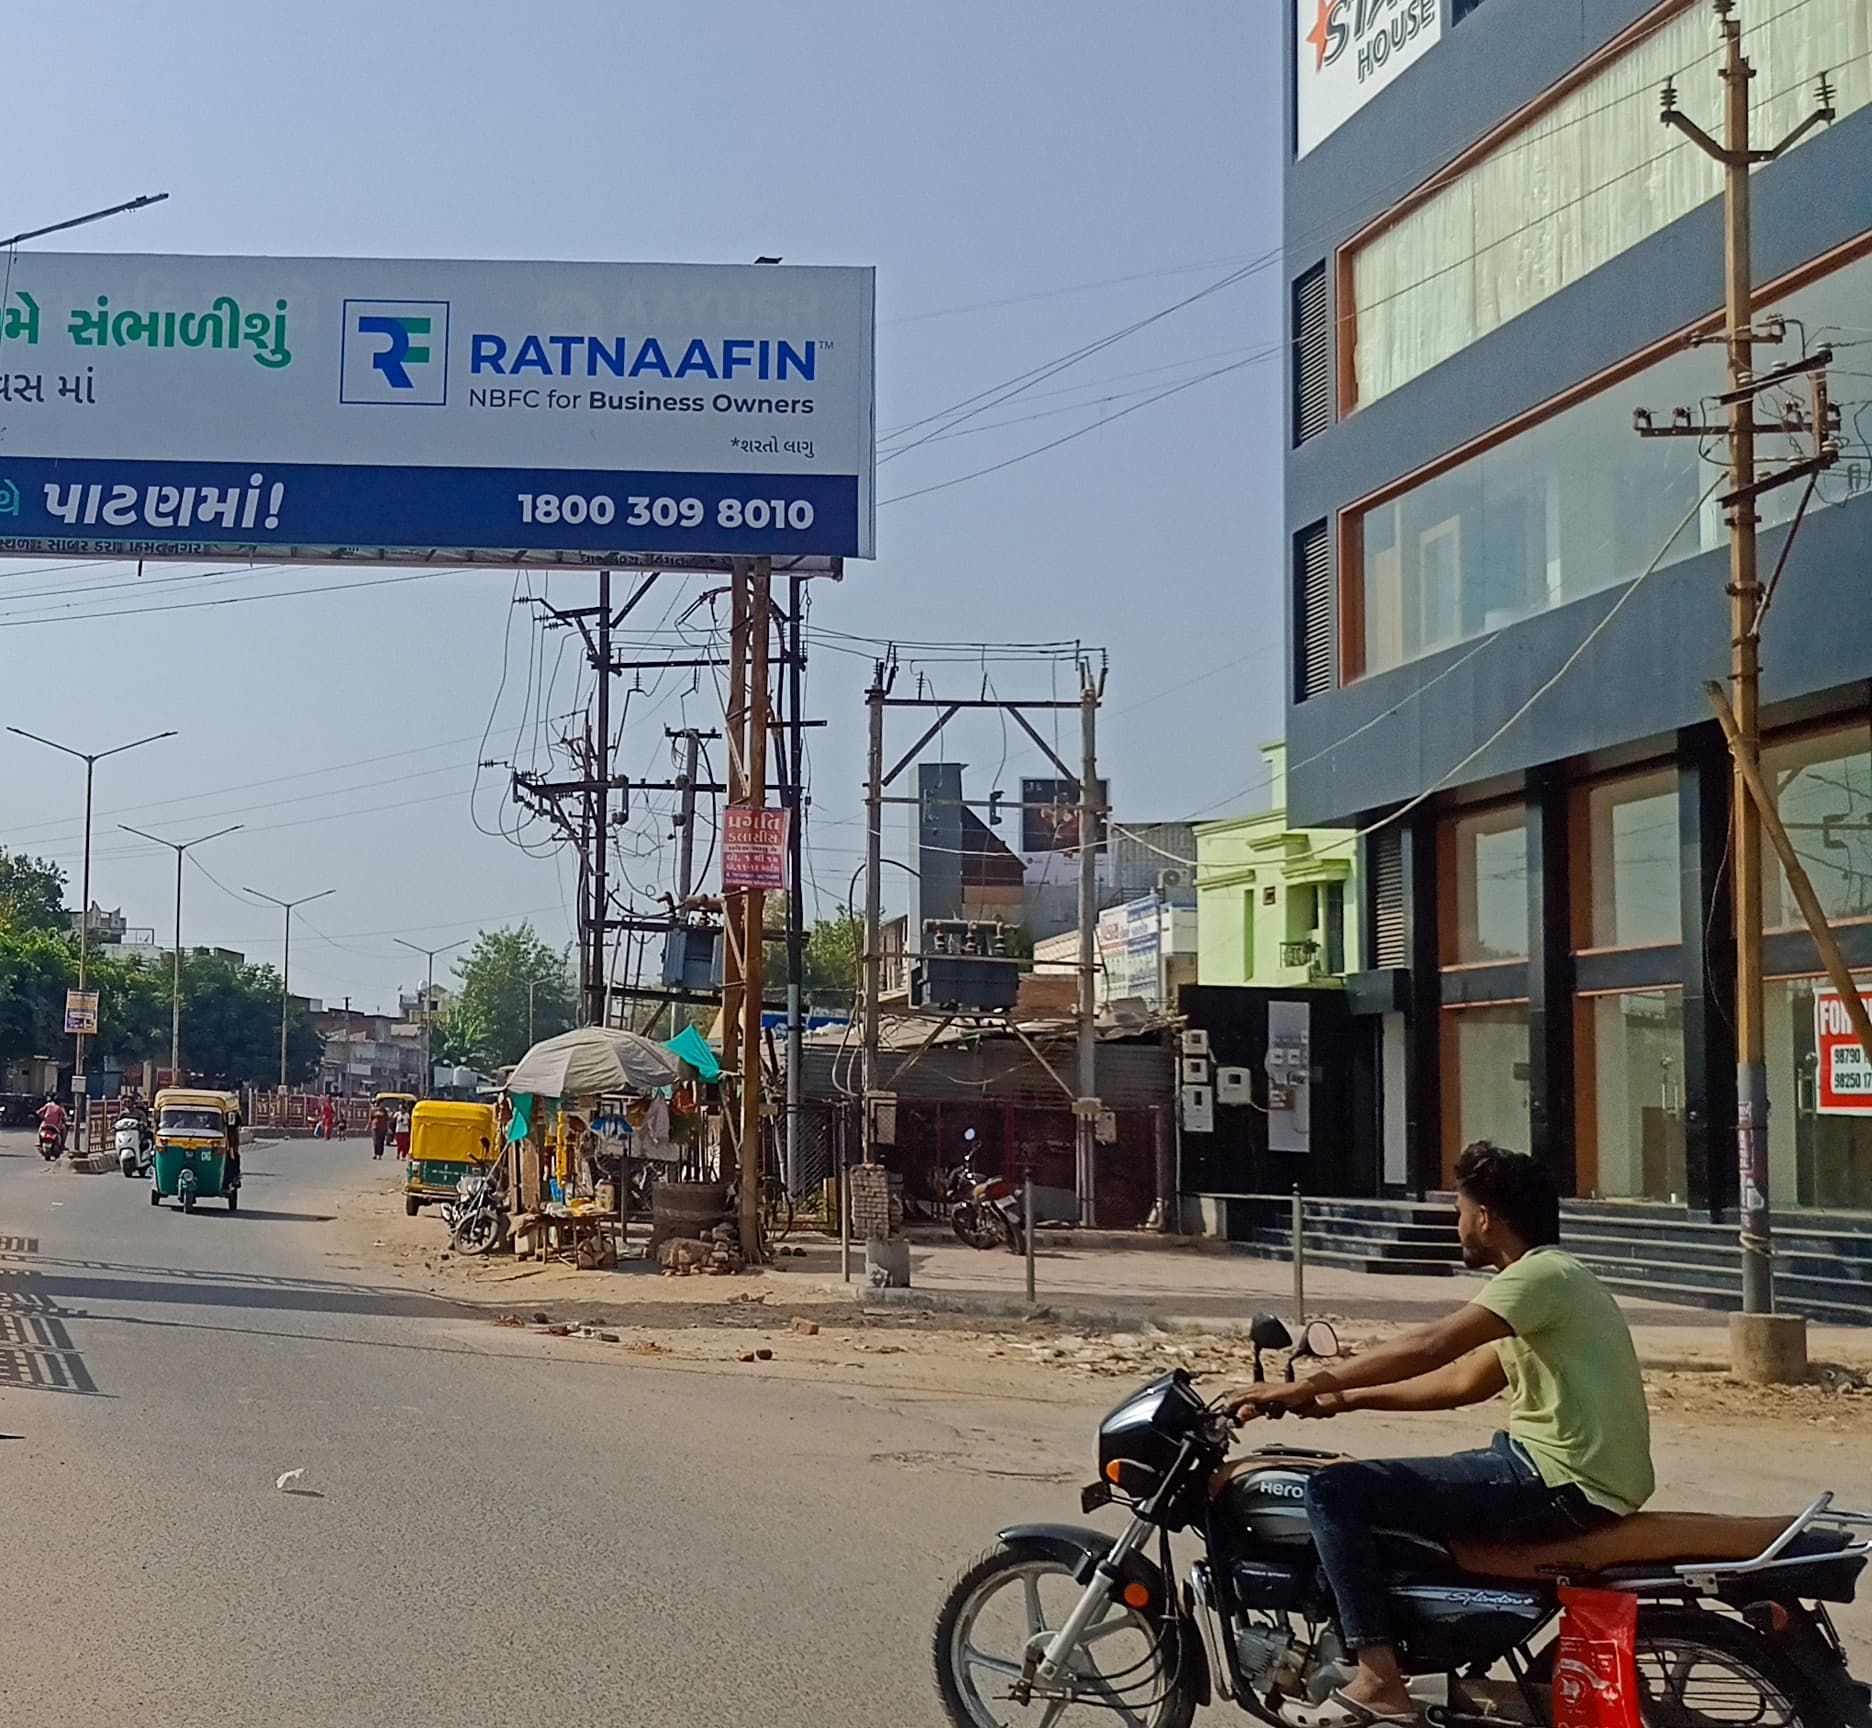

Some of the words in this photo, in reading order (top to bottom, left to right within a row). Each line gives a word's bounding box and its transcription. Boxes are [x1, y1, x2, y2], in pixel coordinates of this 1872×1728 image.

[1358, 0, 1435, 84] HOUSE
[67, 296, 292, 369] સંભાળીશું
[470, 334, 815, 381] RATNAAFIN
[58, 368, 95, 404] માં
[470, 388, 540, 409] NBFC
[548, 389, 581, 409] for
[589, 390, 704, 412] Business
[712, 393, 814, 414] Owners
[784, 437, 814, 458] લાગુ
[44, 473, 285, 530] પાટણમાં!
[519, 494, 615, 525] 1800
[628, 496, 704, 527] 309
[717, 499, 814, 530] 8010
[1834, 1048, 1861, 1063] 98790
[1834, 1072, 1861, 1088] 98250
[1260, 1481, 1304, 1499] Hero
